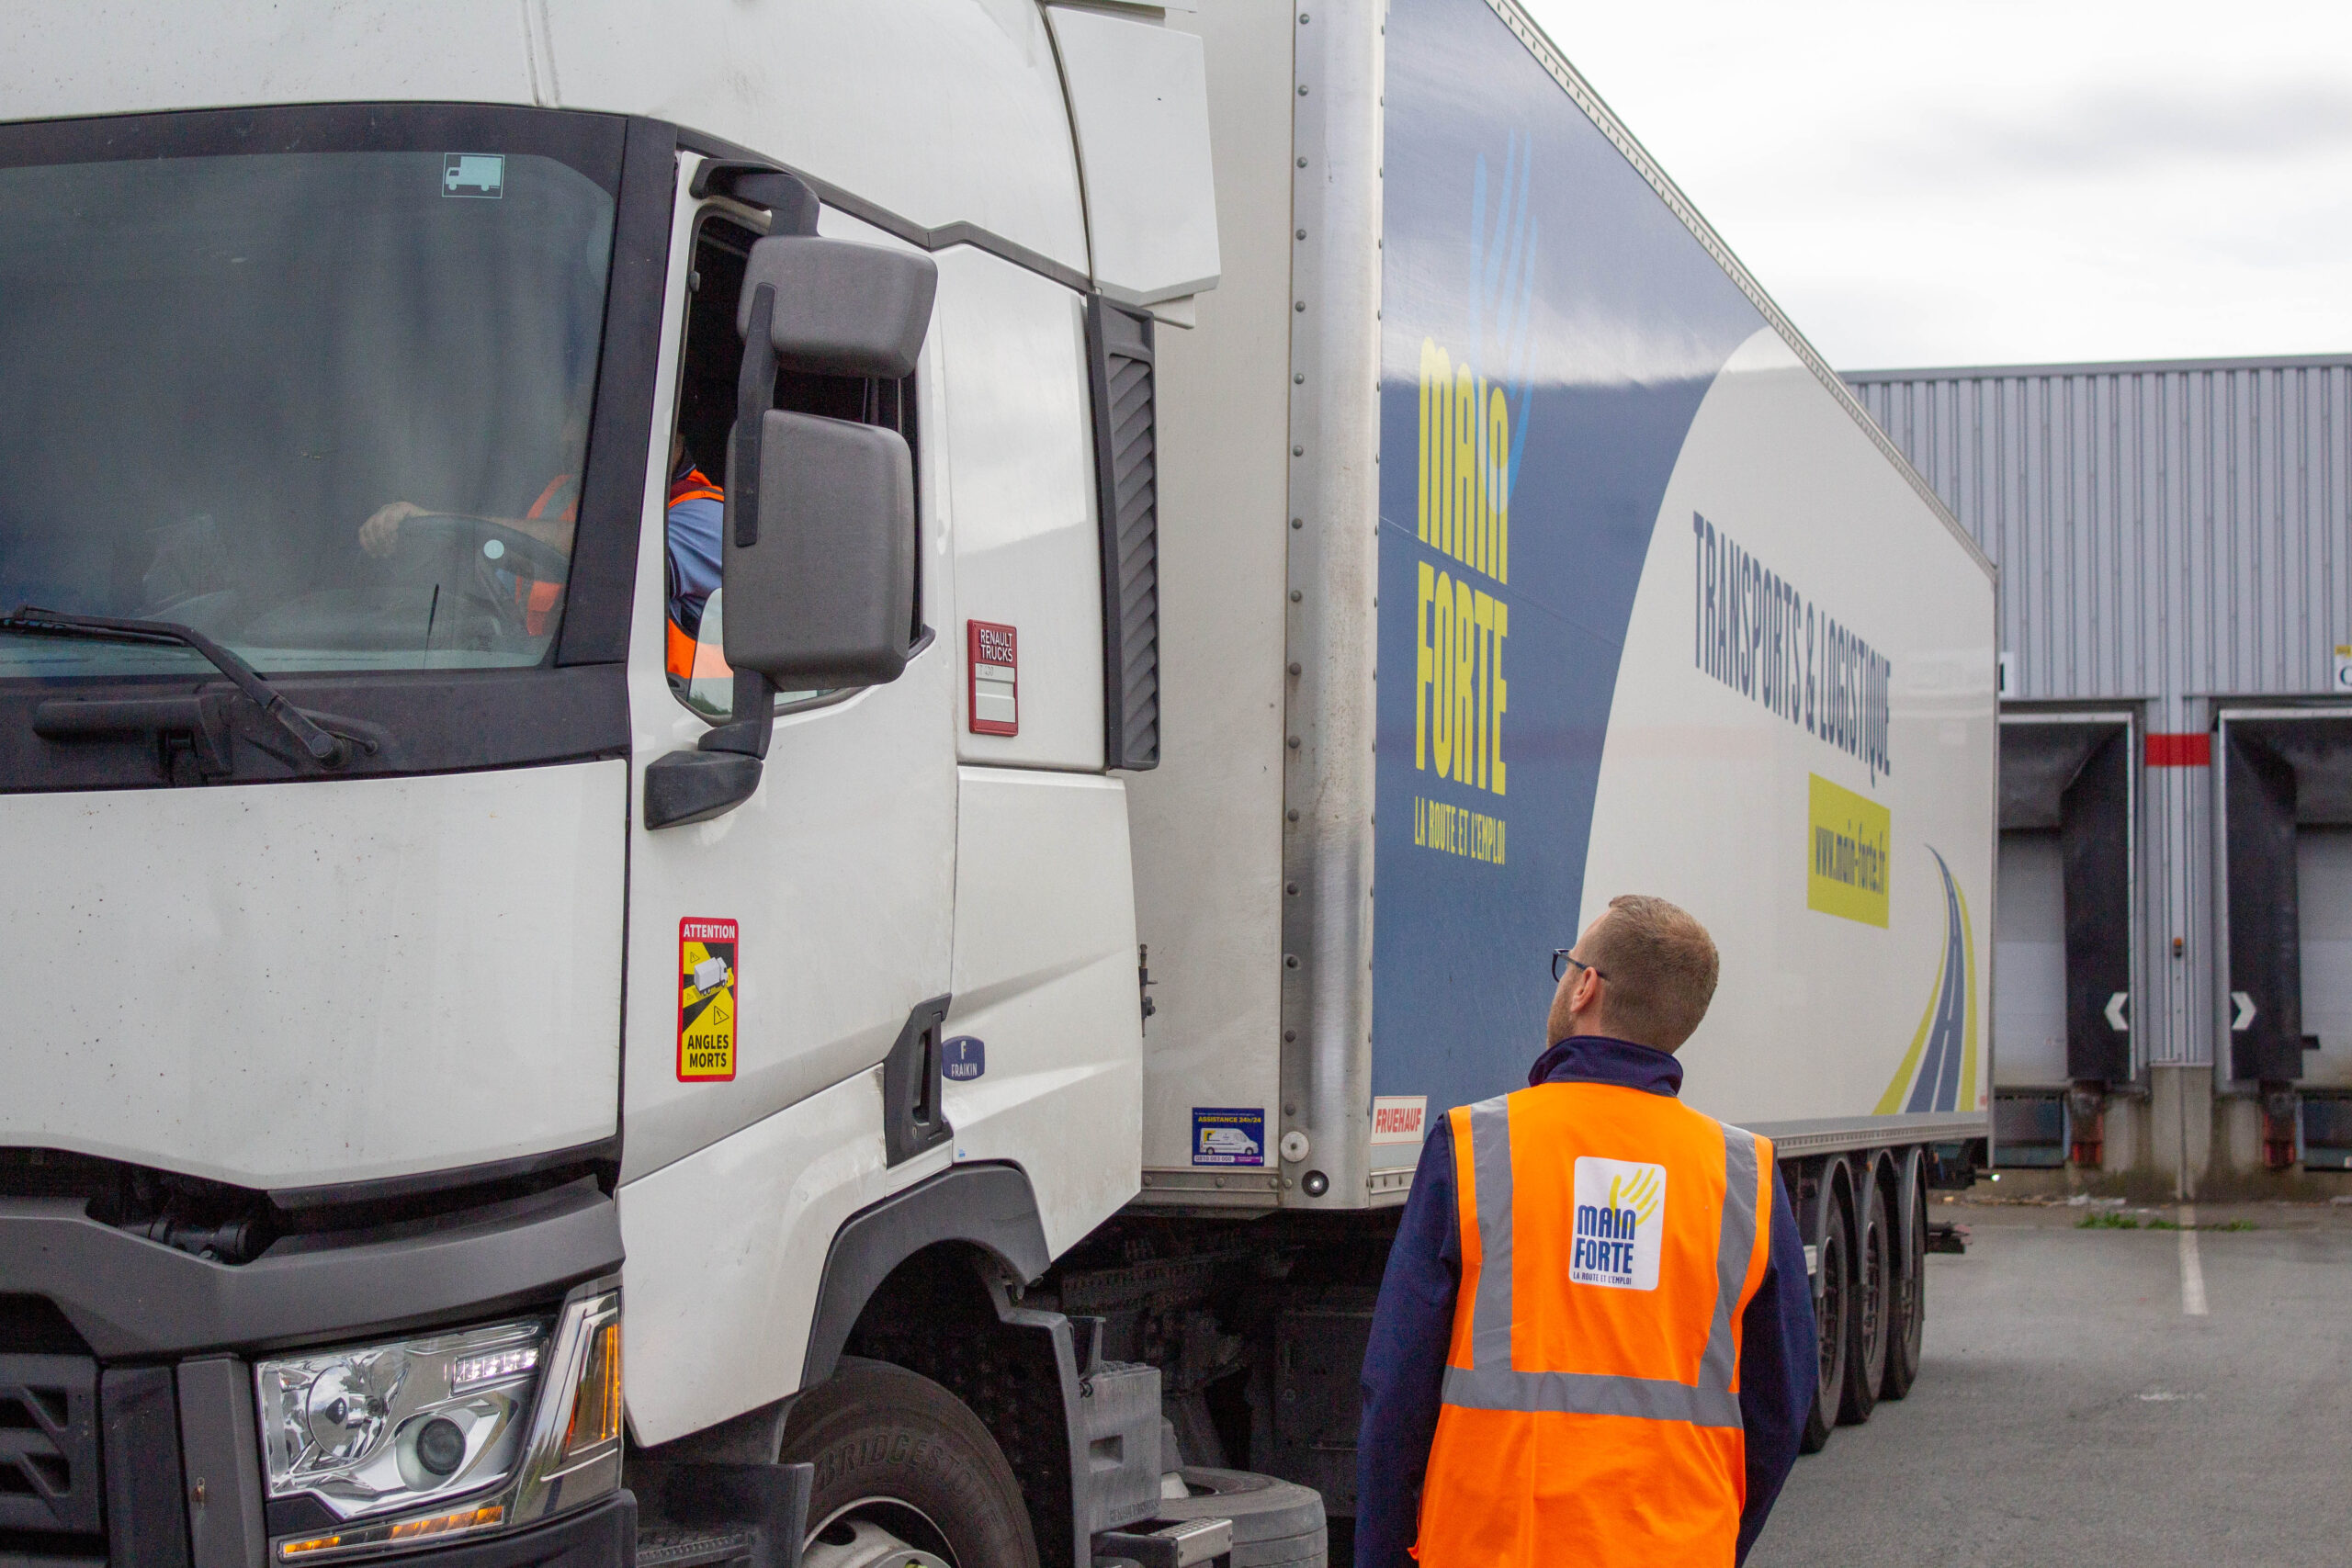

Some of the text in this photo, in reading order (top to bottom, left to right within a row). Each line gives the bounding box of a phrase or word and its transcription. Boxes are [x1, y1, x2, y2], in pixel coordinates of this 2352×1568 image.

[980, 628, 1012, 647] RENAULT
[980, 644, 1013, 662] TRUCKS
[1693, 510, 1891, 789] TRANSPORTS & LOGISTIQUE
[1416, 559, 1508, 796] FORTE
[1415, 795, 1506, 865] LA ROUTE ET L'EMPLOI
[683, 923, 736, 939] ATTENTION
[687, 1033, 729, 1050] ANGLES
[689, 1052, 727, 1068] MORTS
[951, 1063, 978, 1077] FRAIKIN
[1375, 1108, 1422, 1134] FRUEHAUF
[1574, 1237, 1634, 1274] FORTE
[1573, 1271, 1632, 1285] LA ROUTE ET L'EMPLOI
